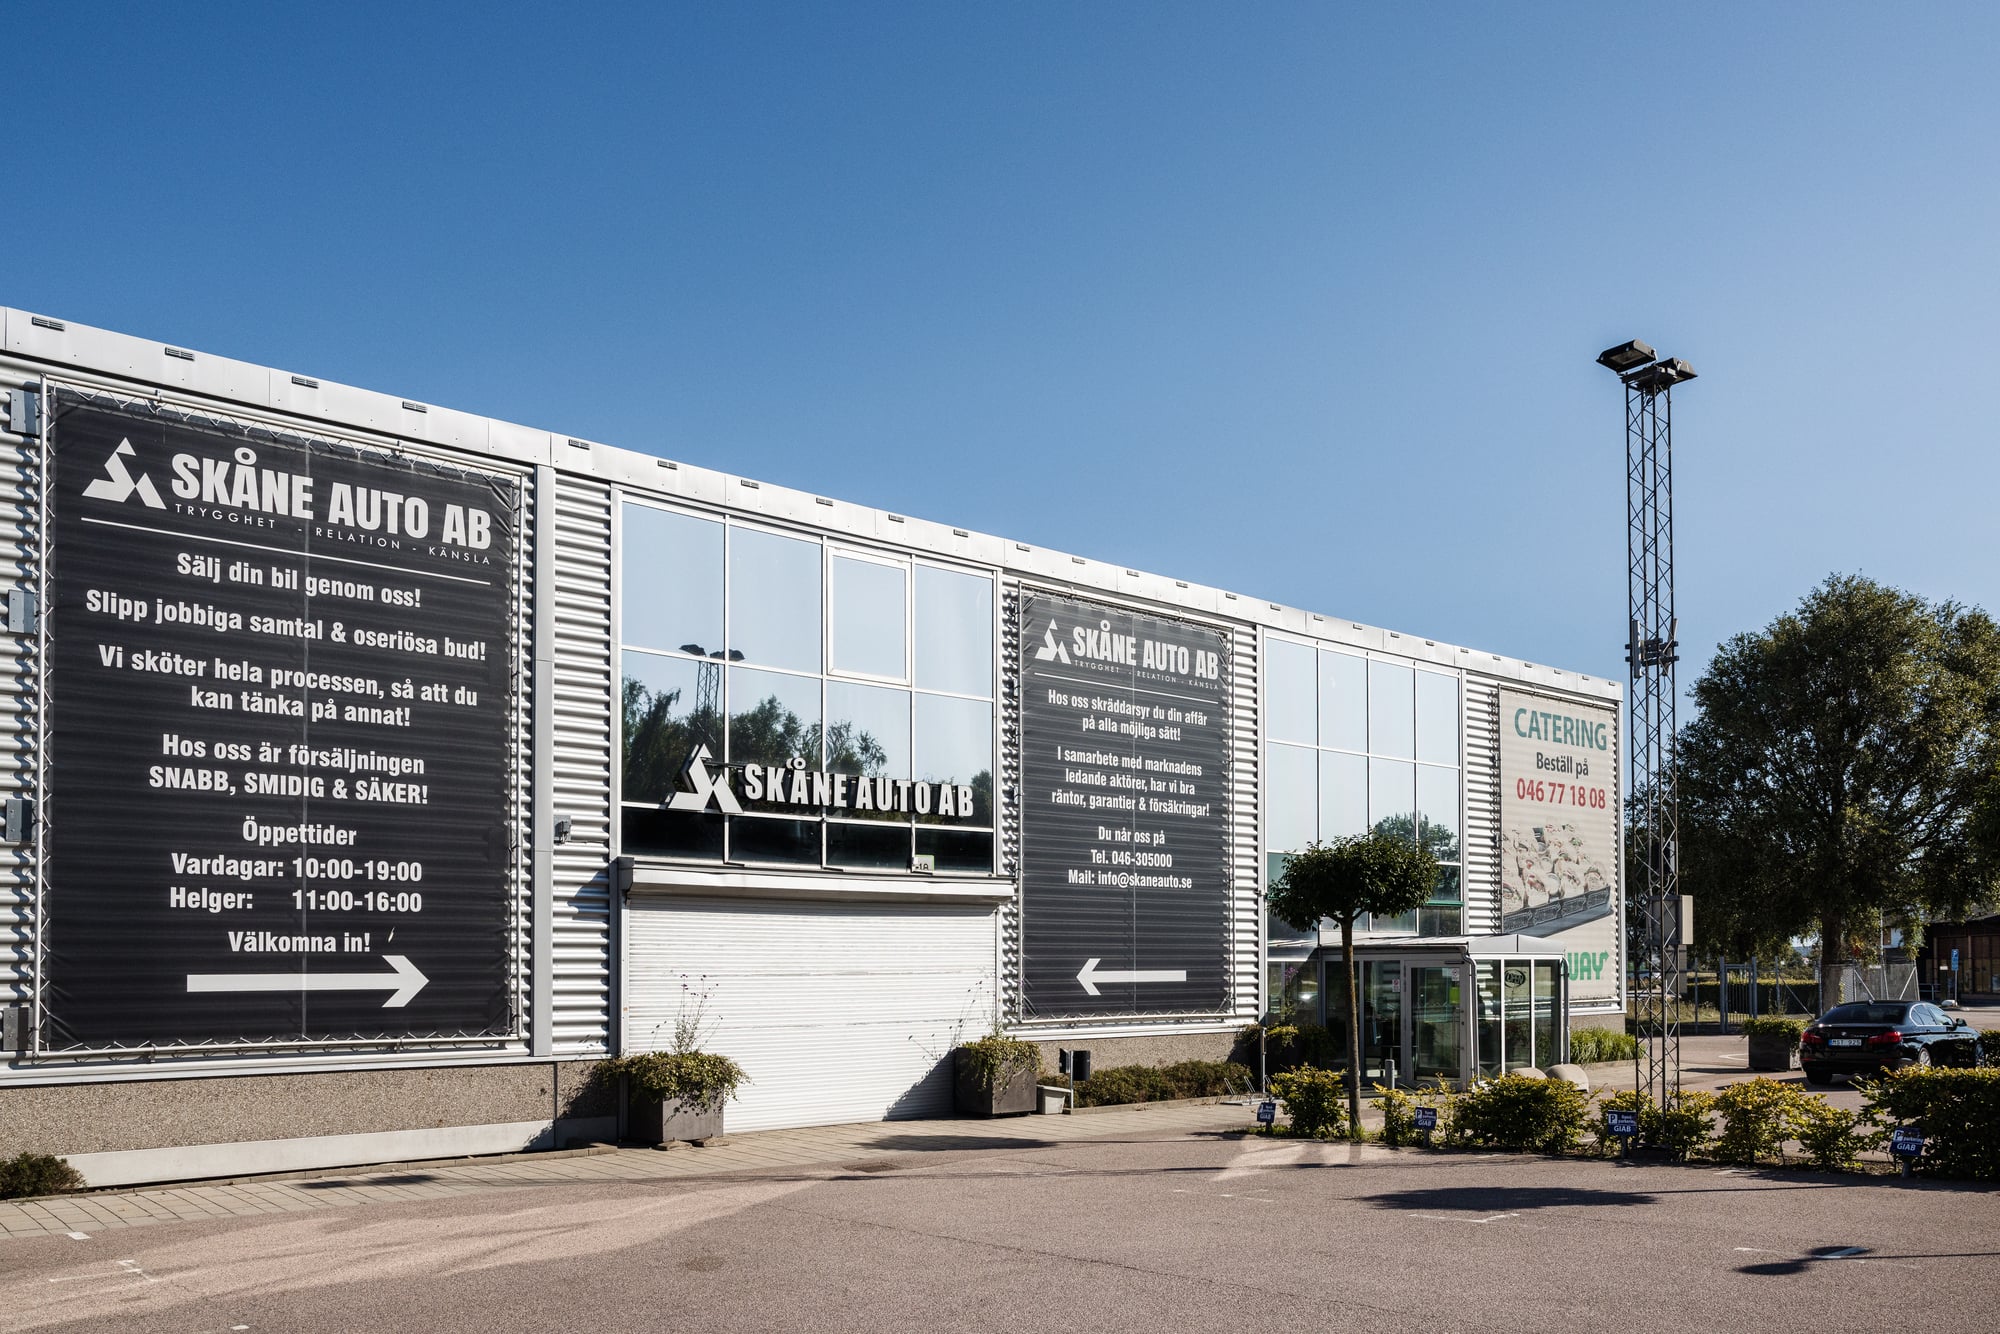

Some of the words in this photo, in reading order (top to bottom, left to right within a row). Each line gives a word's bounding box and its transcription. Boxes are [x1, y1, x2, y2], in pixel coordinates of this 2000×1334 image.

[172, 447, 313, 519] SKÅNE
[329, 483, 428, 539] AUTO
[442, 505, 491, 550] AB
[175, 504, 276, 529] TRYGGHET
[316, 527, 400, 550] RELATION
[428, 546, 491, 565] KÄNSLA
[177, 553, 221, 583] Sälj
[229, 561, 264, 585] din
[271, 567, 298, 590] bil
[305, 576, 374, 602] genom
[381, 585, 421, 607] oss!
[86, 590, 148, 622] Slipp
[156, 598, 242, 632] jobbiga
[250, 611, 323, 640] samtal
[331, 623, 347, 643] &
[353, 626, 438, 655] oseriösa
[444, 636, 486, 660] bud!
[1073, 620, 1136, 666] SKÅNE
[1142, 640, 1188, 674] AUTO
[1195, 651, 1218, 679] AB
[99, 645, 123, 669] Vi
[131, 649, 207, 676] sköter
[215, 658, 264, 684] hela
[271, 669, 385, 698] processen,
[391, 674, 414, 698] så
[420, 681, 449, 704] att
[455, 684, 478, 706] du
[1074, 660, 1119, 673] TRYGGHET
[1137, 670, 1176, 683] RELATION
[191, 686, 233, 711] kan
[241, 690, 305, 716] tänka
[311, 696, 337, 725] på
[345, 706, 410, 727] annat!
[1048, 689, 1068, 706] Hos
[1072, 695, 1088, 708] oss
[1092, 696, 1150, 718] skräddarsyr
[1153, 706, 1165, 719] du
[1168, 707, 1182, 722] din
[1185, 710, 1207, 726] affär
[1082, 715, 1096, 731] på
[1098, 718, 1117, 732] alla
[1121, 722, 1156, 739] möjliga
[1159, 727, 1181, 741] sätt!
[1514, 708, 1607, 751] CATERING
[162, 734, 206, 757] Hos
[213, 741, 252, 761] oss
[258, 741, 282, 763] är
[288, 744, 425, 775] försäljningen
[1058, 746, 1061, 760] I
[1064, 750, 1118, 766] samarbete
[1122, 755, 1142, 769] med
[1145, 758, 1202, 775] marknadens
[1536, 752, 1573, 775] Beställ
[1575, 758, 1589, 778] på
[149, 765, 236, 795] SNABB,
[244, 773, 324, 798] SMIDIG
[332, 779, 347, 799] &
[355, 777, 428, 804] SÄKER!
[744, 758, 846, 807] SKÅNE
[855, 776, 931, 814] AUTO
[938, 784, 974, 817] AB
[1066, 768, 1106, 786] ledande
[1110, 775, 1148, 792] aktörer,
[1150, 779, 1166, 792] har
[1169, 781, 1177, 793] vi
[1180, 781, 1195, 795] bra
[1517, 778, 1544, 802] 046
[1548, 782, 1566, 804] 77
[1570, 785, 1585, 806] 18
[1589, 788, 1605, 809] 08
[1052, 790, 1086, 807] räntor,
[1089, 794, 1135, 810] garantier
[1138, 798, 1146, 811] &
[1149, 799, 1210, 818] försäkringar!
[242, 816, 357, 846] Öppettider
[1099, 826, 1112, 840] Du
[1115, 826, 1131, 842] når
[1134, 832, 1150, 843] oss
[1153, 831, 1165, 846] på
[171, 853, 284, 880] Vardagar:
[292, 858, 422, 881] 10:00-19:00
[1091, 849, 1109, 864] Tel.
[1112, 851, 1172, 867] 046-305000
[1068, 870, 1094, 884] Mail:
[1098, 870, 1192, 888] info@skaneauto.se
[170, 888, 253, 913] Helger:
[292, 890, 422, 912] 11:00-16:00
[228, 931, 336, 952] Välkomna
[344, 932, 370, 952] in!
[1897, 1143, 1916, 1151] GIAB
